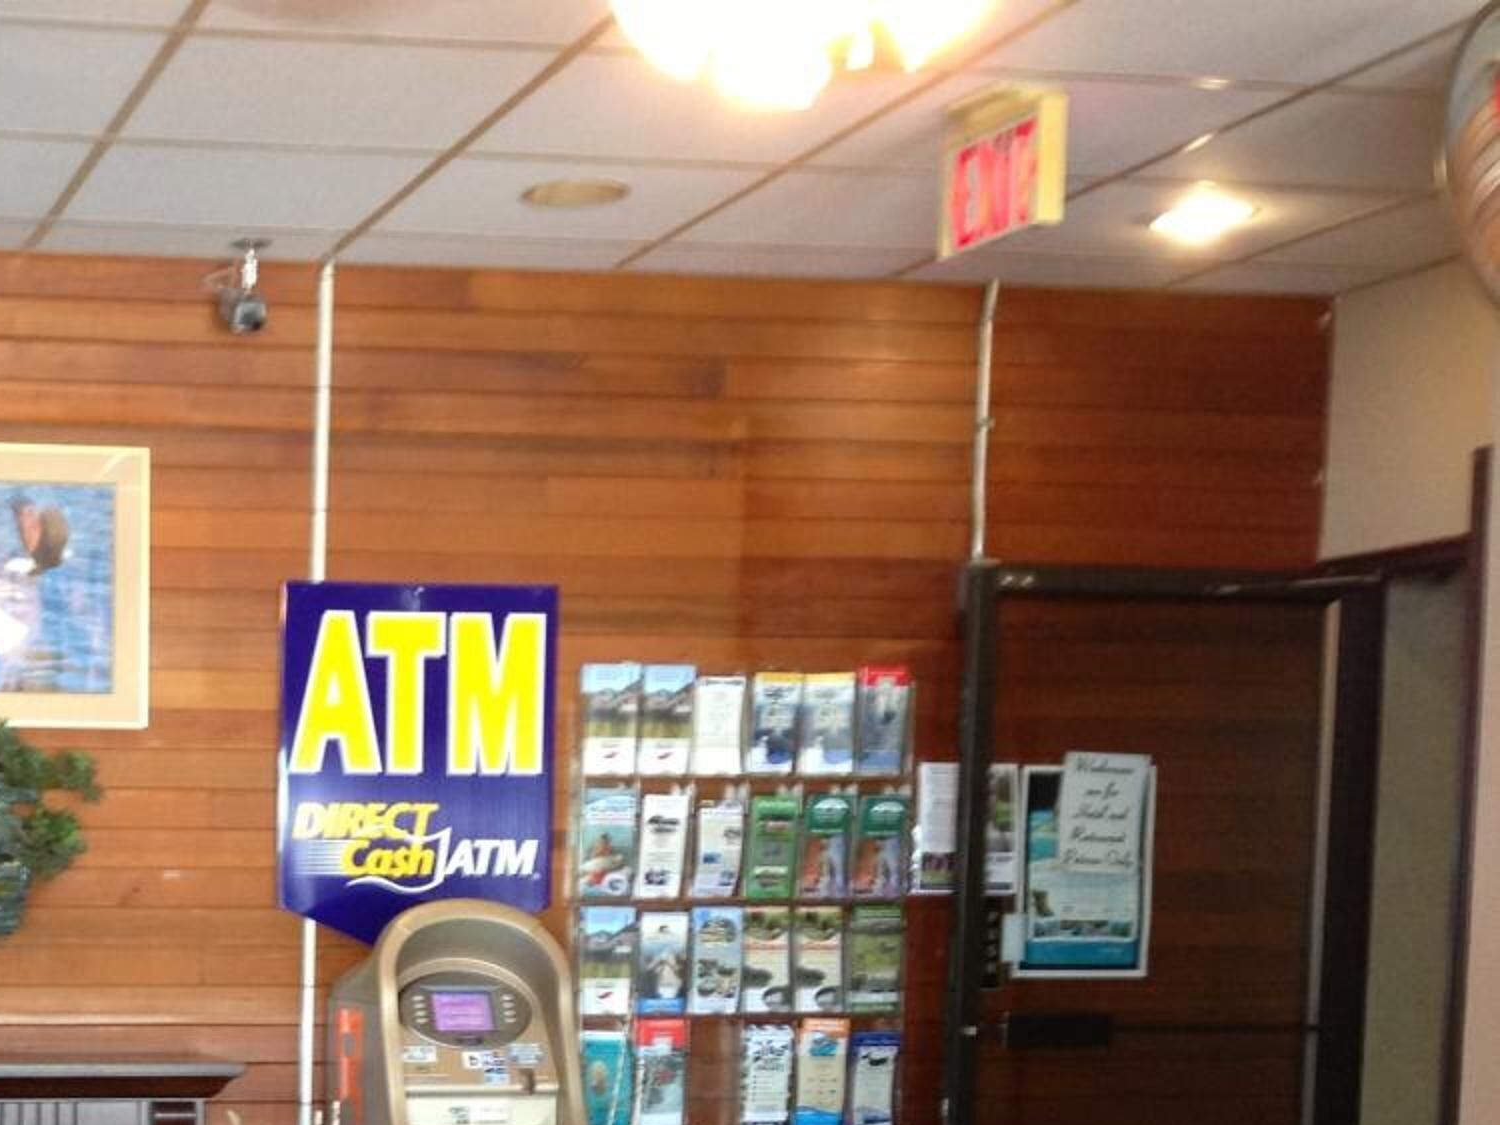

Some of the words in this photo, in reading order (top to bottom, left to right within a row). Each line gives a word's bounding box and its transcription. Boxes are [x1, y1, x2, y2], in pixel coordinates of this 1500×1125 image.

[289, 610, 547, 775] ATM
[293, 801, 438, 839] DIRECT
[340, 840, 432, 878] Cash
[445, 840, 538, 876] ATM
